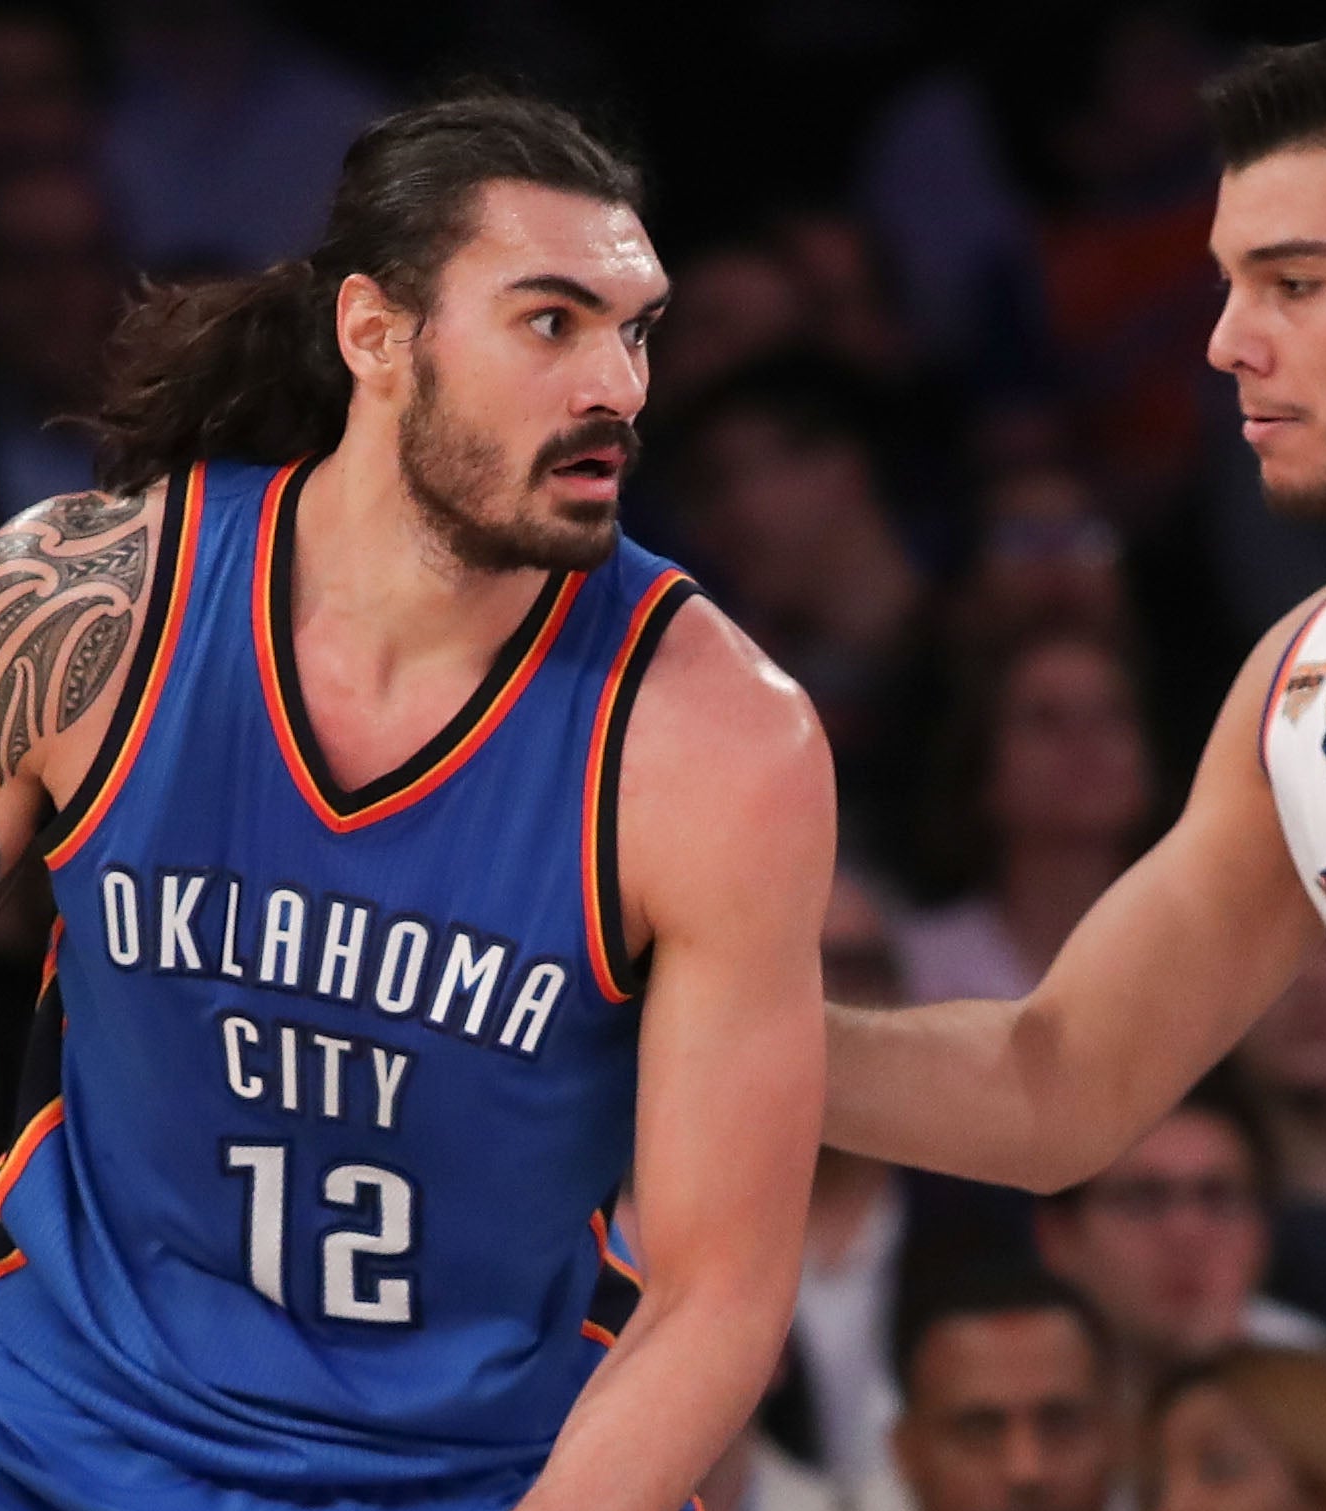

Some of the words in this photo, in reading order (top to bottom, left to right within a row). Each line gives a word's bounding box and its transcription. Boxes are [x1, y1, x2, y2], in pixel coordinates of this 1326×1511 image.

[101, 869, 567, 1054] OKLAHOMA
[220, 1015, 408, 1129] CITY
[226, 1142, 415, 1326] 12
